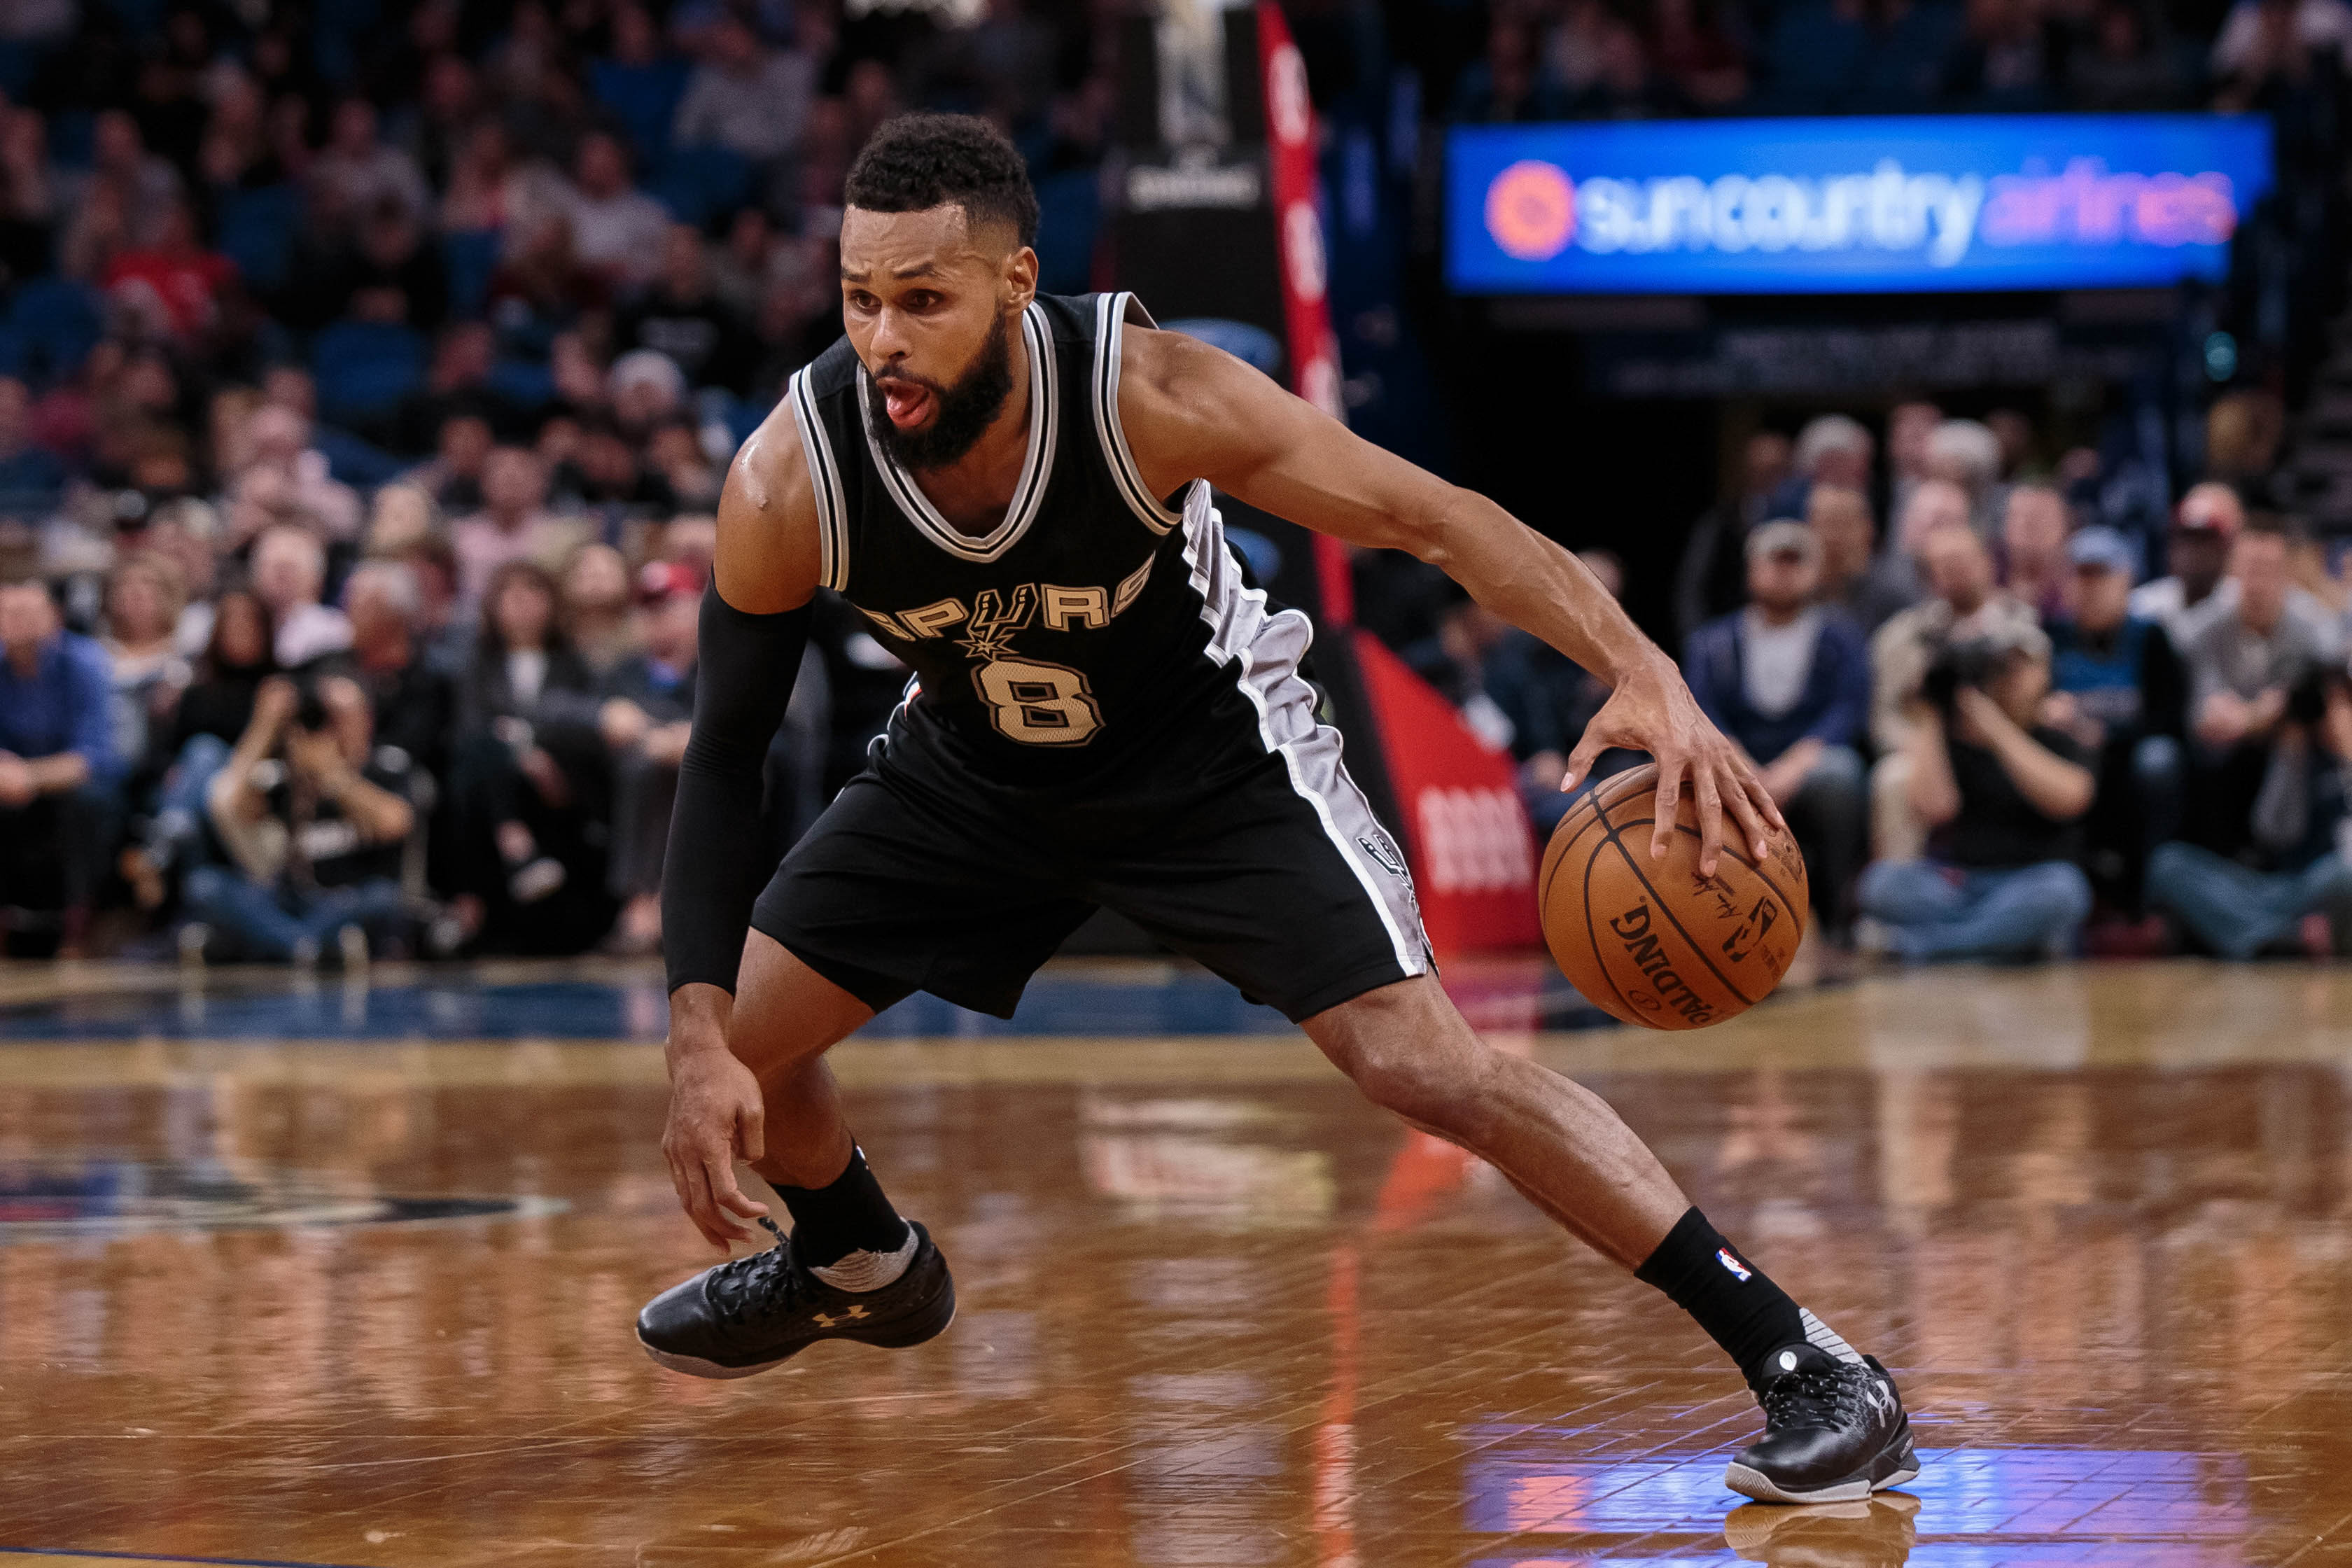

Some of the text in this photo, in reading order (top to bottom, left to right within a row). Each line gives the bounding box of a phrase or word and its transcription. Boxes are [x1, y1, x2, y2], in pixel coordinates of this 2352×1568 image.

[854, 550, 1156, 659] SPURS
[971, 655, 1106, 748] 8
[1610, 903, 1714, 1025] PALDING
